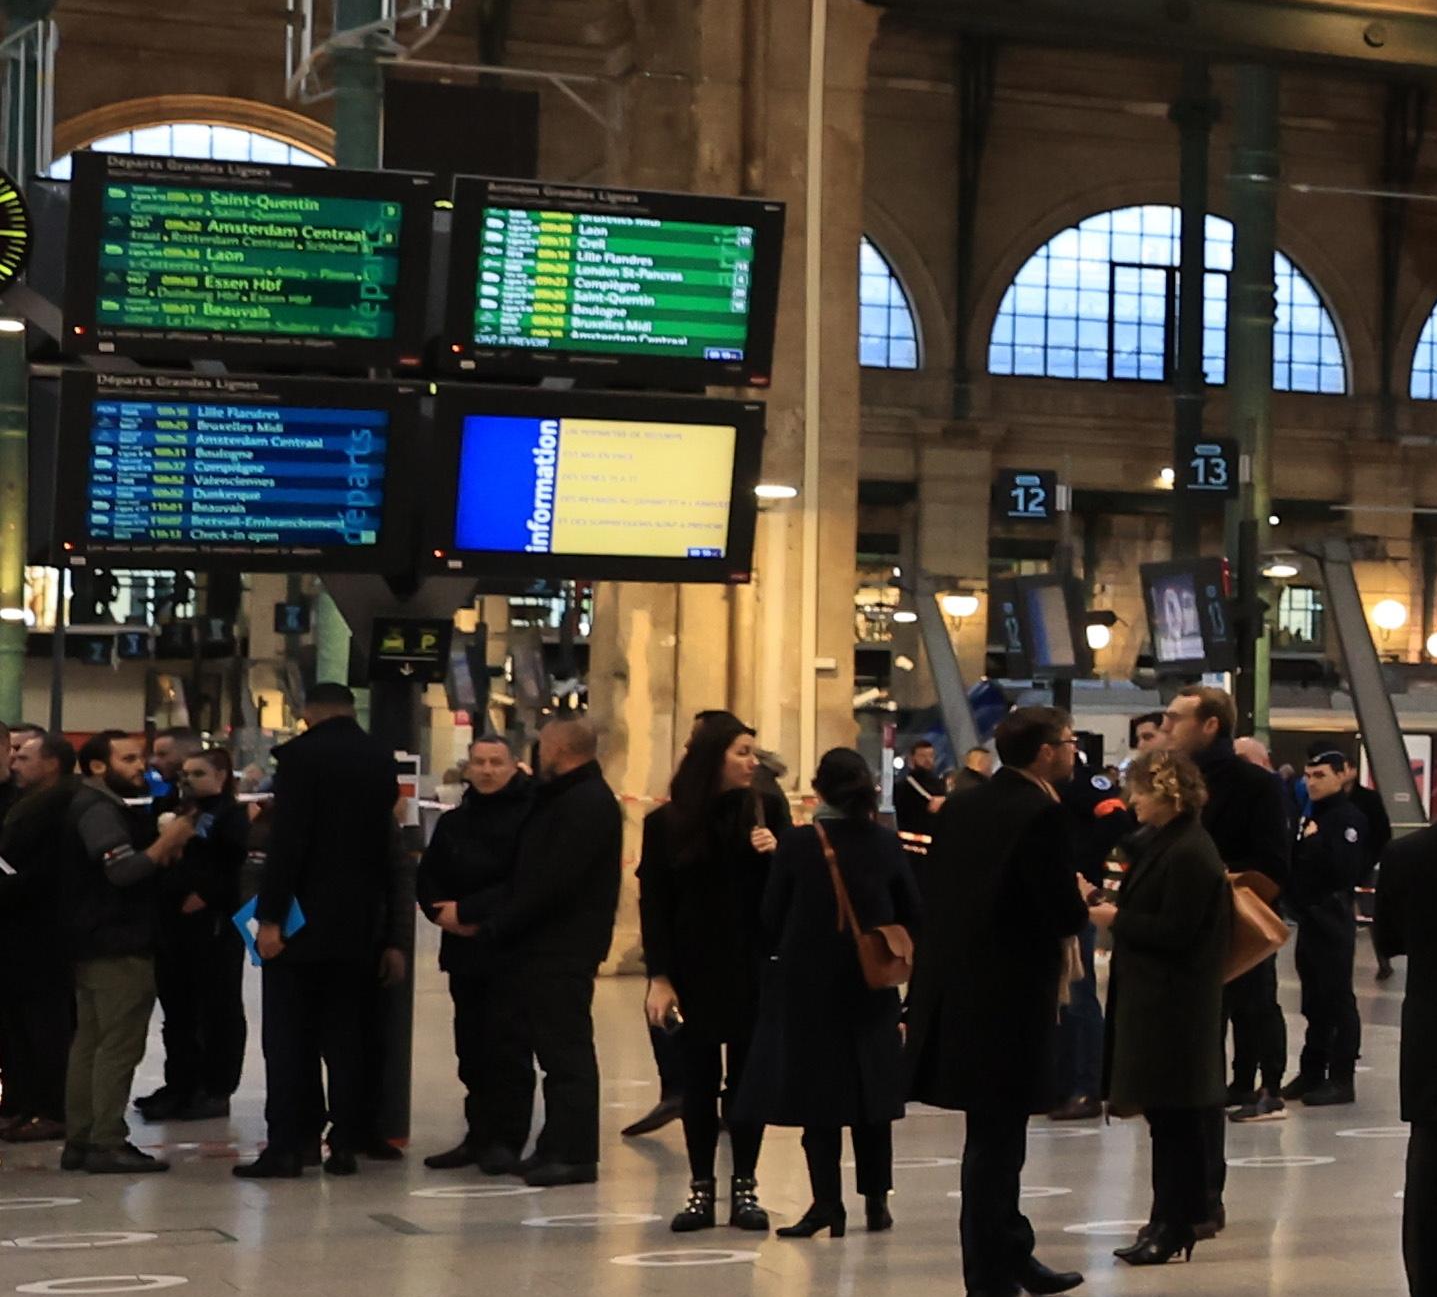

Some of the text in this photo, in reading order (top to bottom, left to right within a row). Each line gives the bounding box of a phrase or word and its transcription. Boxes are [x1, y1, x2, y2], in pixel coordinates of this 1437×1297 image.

[211, 190, 319, 211] Saint-Quentin
[207, 221, 298, 238] Amsterdam
[302, 226, 366, 243] Centraal
[578, 225, 608, 237] Laon
[577, 239, 605, 250] Creil
[206, 248, 244, 262] Laon
[576, 252, 601, 263] Lille
[605, 254, 653, 267] Flandres
[575, 264, 683, 282] London St-Pancras
[205, 275, 281, 292] Essen Hbf
[574, 291, 655, 307] Saint-Quentin
[203, 303, 271, 318] Beauvais
[572, 305, 627, 318] Boulogne
[571, 317, 652, 332] Bruxelles Midi
[198, 406, 280, 420] Lille Flandres
[197, 420, 283, 433] Bruxelles Midi
[196, 434, 323, 449] Amsterdam Centraal
[1190, 458, 1228, 485] 13
[193, 474, 275, 487] Valenciennes
[525, 420, 558, 552] information
[193, 488, 261, 501] Dunkerque
[1010, 487, 1046, 512] 12
[190, 530, 279, 544] Check-in open
